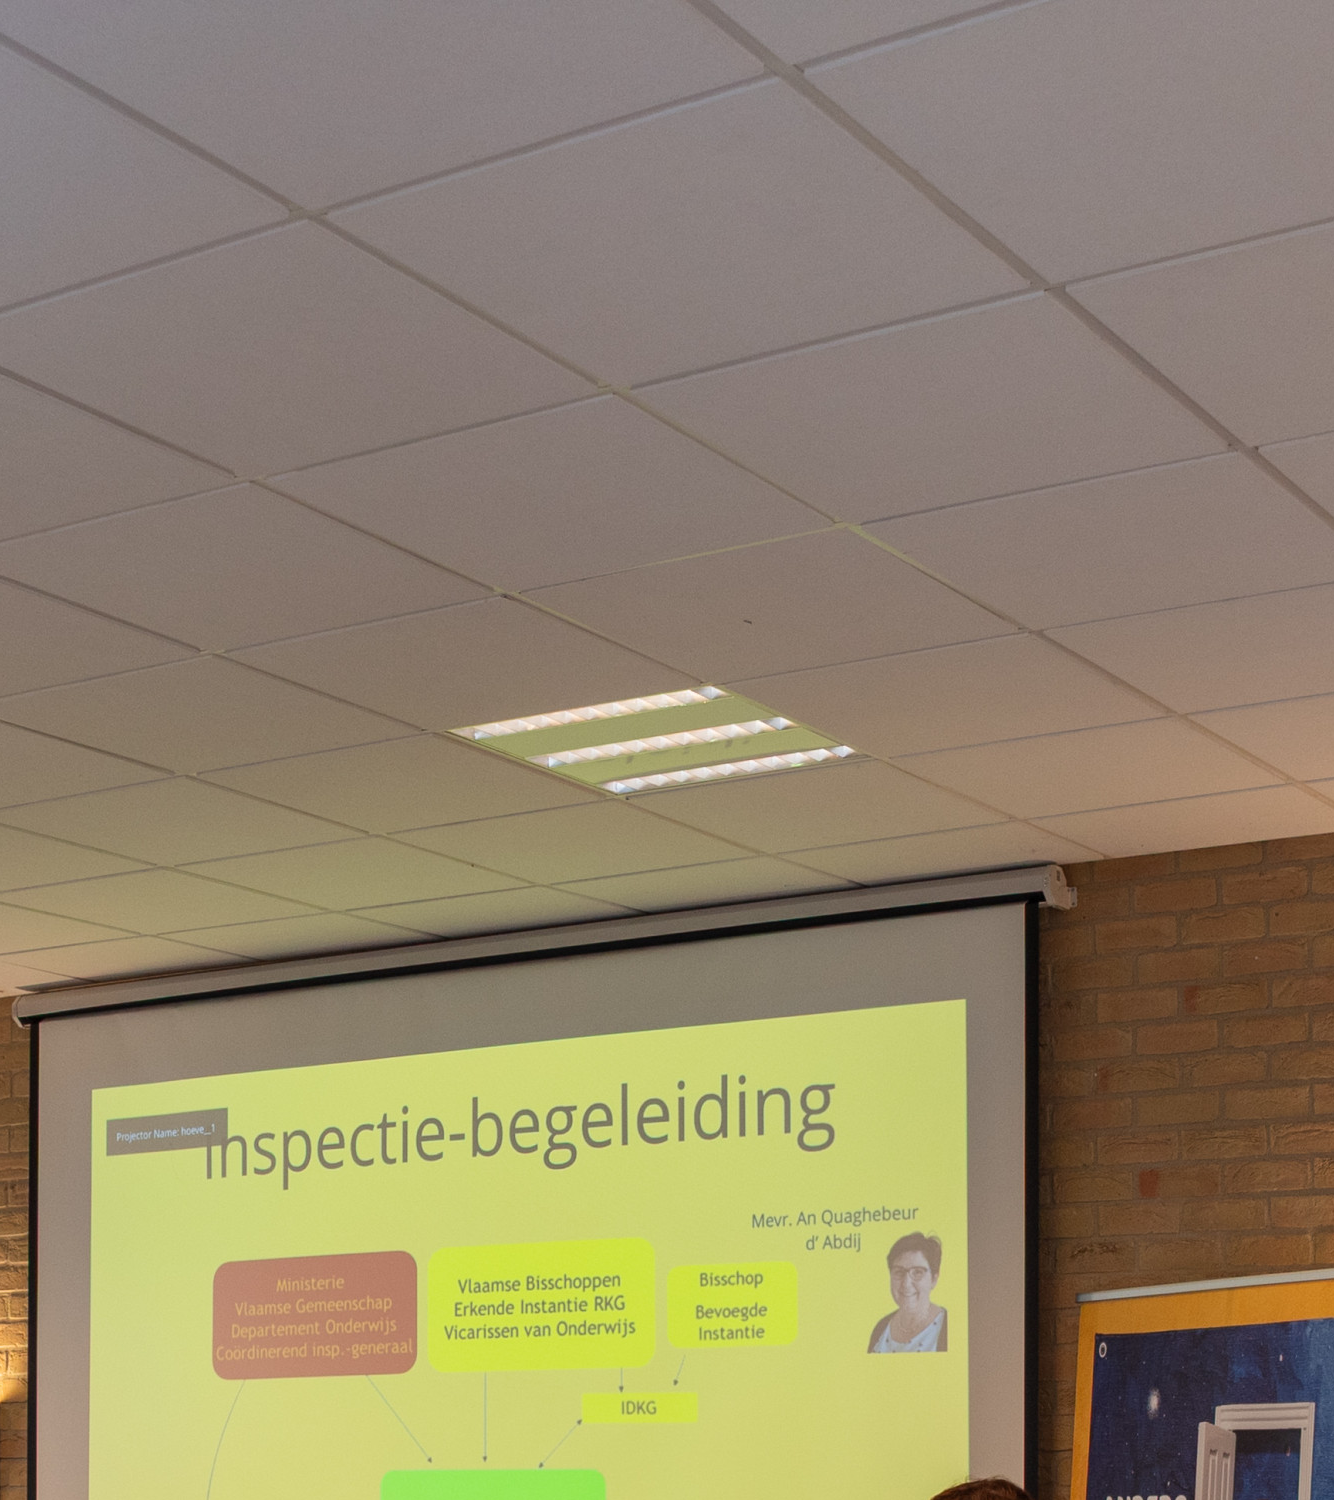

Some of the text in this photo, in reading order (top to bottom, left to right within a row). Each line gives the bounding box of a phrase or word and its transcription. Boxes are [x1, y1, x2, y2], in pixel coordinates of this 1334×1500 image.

[116, 1131, 152, 1144] Projector
[154, 1129, 179, 1139] Name:
[751, 1205, 919, 1229] Mevr. An Quaghebeur
[822, 1233, 862, 1252] Abdij
[276, 1275, 345, 1293] Ministerie
[458, 1273, 621, 1294] Vlaamse Bisschoppen
[699, 1270, 764, 1288] Bisschop
[234, 1296, 393, 1317] Vlaamse Gemeenschap
[454, 1295, 626, 1317] Erkende Instantie RKG
[695, 1302, 768, 1321] Bevoegde
[231, 1317, 397, 1341] Departement Onderwijs
[444, 1319, 636, 1340] Vicarissen van Onderwijs
[698, 1325, 765, 1341] Instantie
[216, 1343, 308, 1361] Coördinerend
[621, 1400, 657, 1415] IDKG
